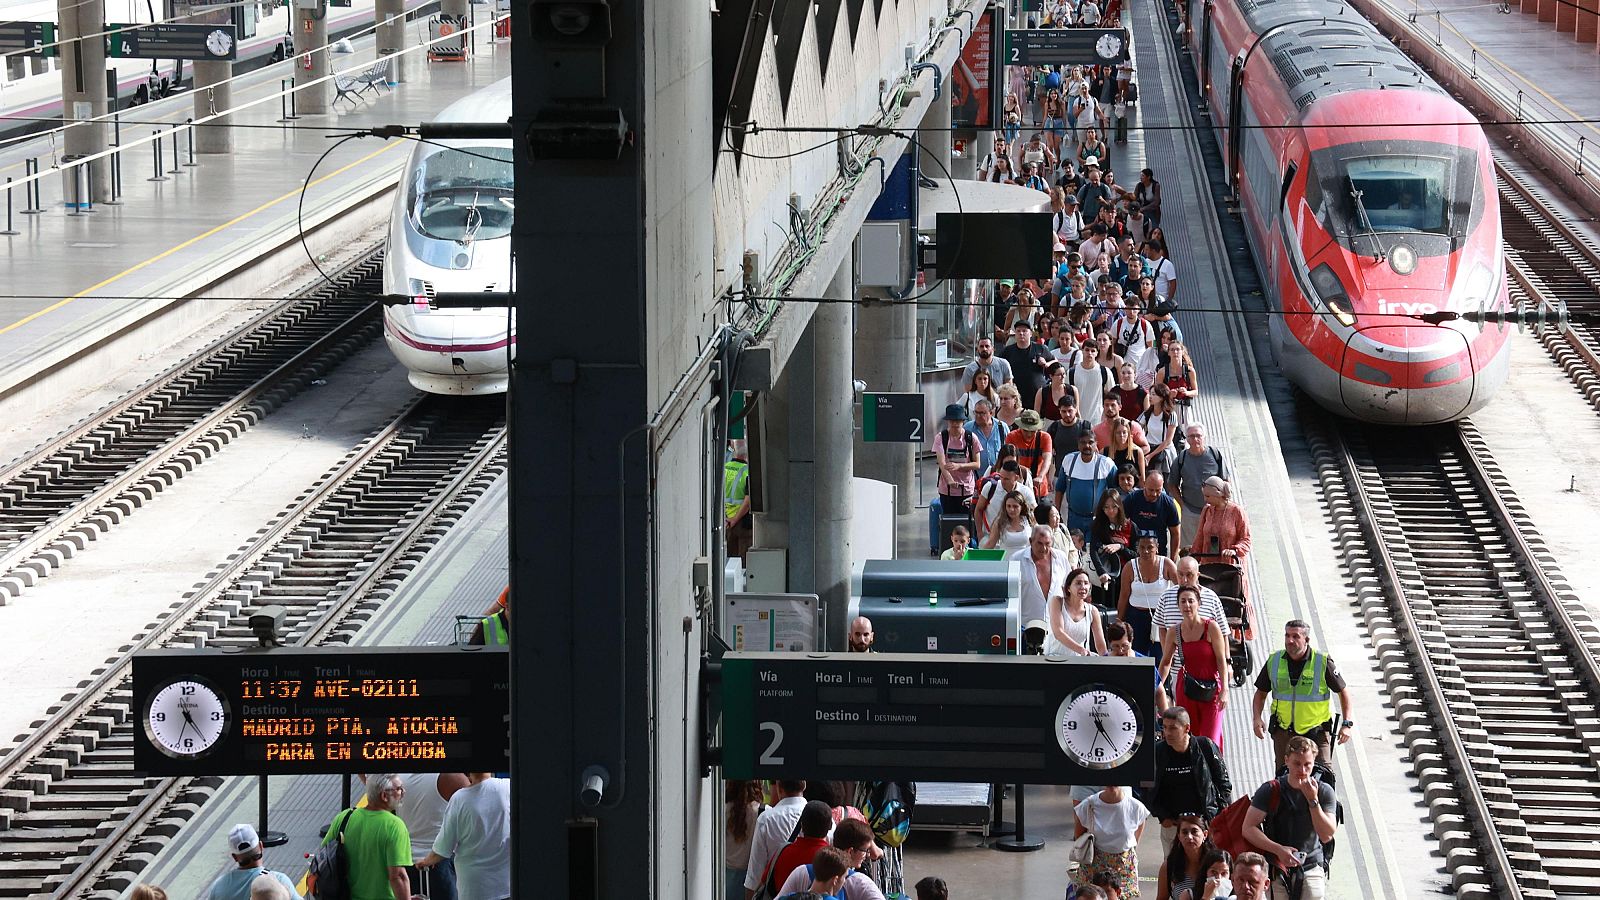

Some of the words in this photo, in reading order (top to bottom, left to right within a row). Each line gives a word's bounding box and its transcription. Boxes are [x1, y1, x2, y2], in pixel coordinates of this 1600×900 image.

[34, 39, 43, 53] 5
[121, 41, 132, 54] 4
[1011, 48, 1020, 61] 2
[909, 418, 921, 439] 2
[241, 667, 269, 677] Hora
[314, 666, 340, 677] Tren
[759, 671, 778, 682] Vía
[815, 672, 843, 683] Hora
[857, 676, 873, 684] TIME
[888, 673, 913, 684] Tren
[929, 677, 949, 685] TRAIN
[181, 686, 195, 695] 12
[242, 680, 301, 698] 11:37
[314, 679, 420, 697] AVE-02111
[1093, 695, 1107, 705] 12
[242, 705, 287, 715] Destino
[815, 710, 860, 721] Destino
[156, 712, 166, 722] 9
[211, 712, 220, 721] 3
[243, 718, 315, 736] MADRID
[327, 717, 372, 735] PTA.
[386, 716, 459, 735] ATOCHA
[1067, 720, 1078, 731] 9
[1122, 722, 1132, 732] 3
[184, 738, 193, 748] 6
[759, 721, 785, 765] 2
[267, 742, 315, 760] PARA
[327, 742, 351, 760] EN
[1094, 747, 1105, 758] 6
